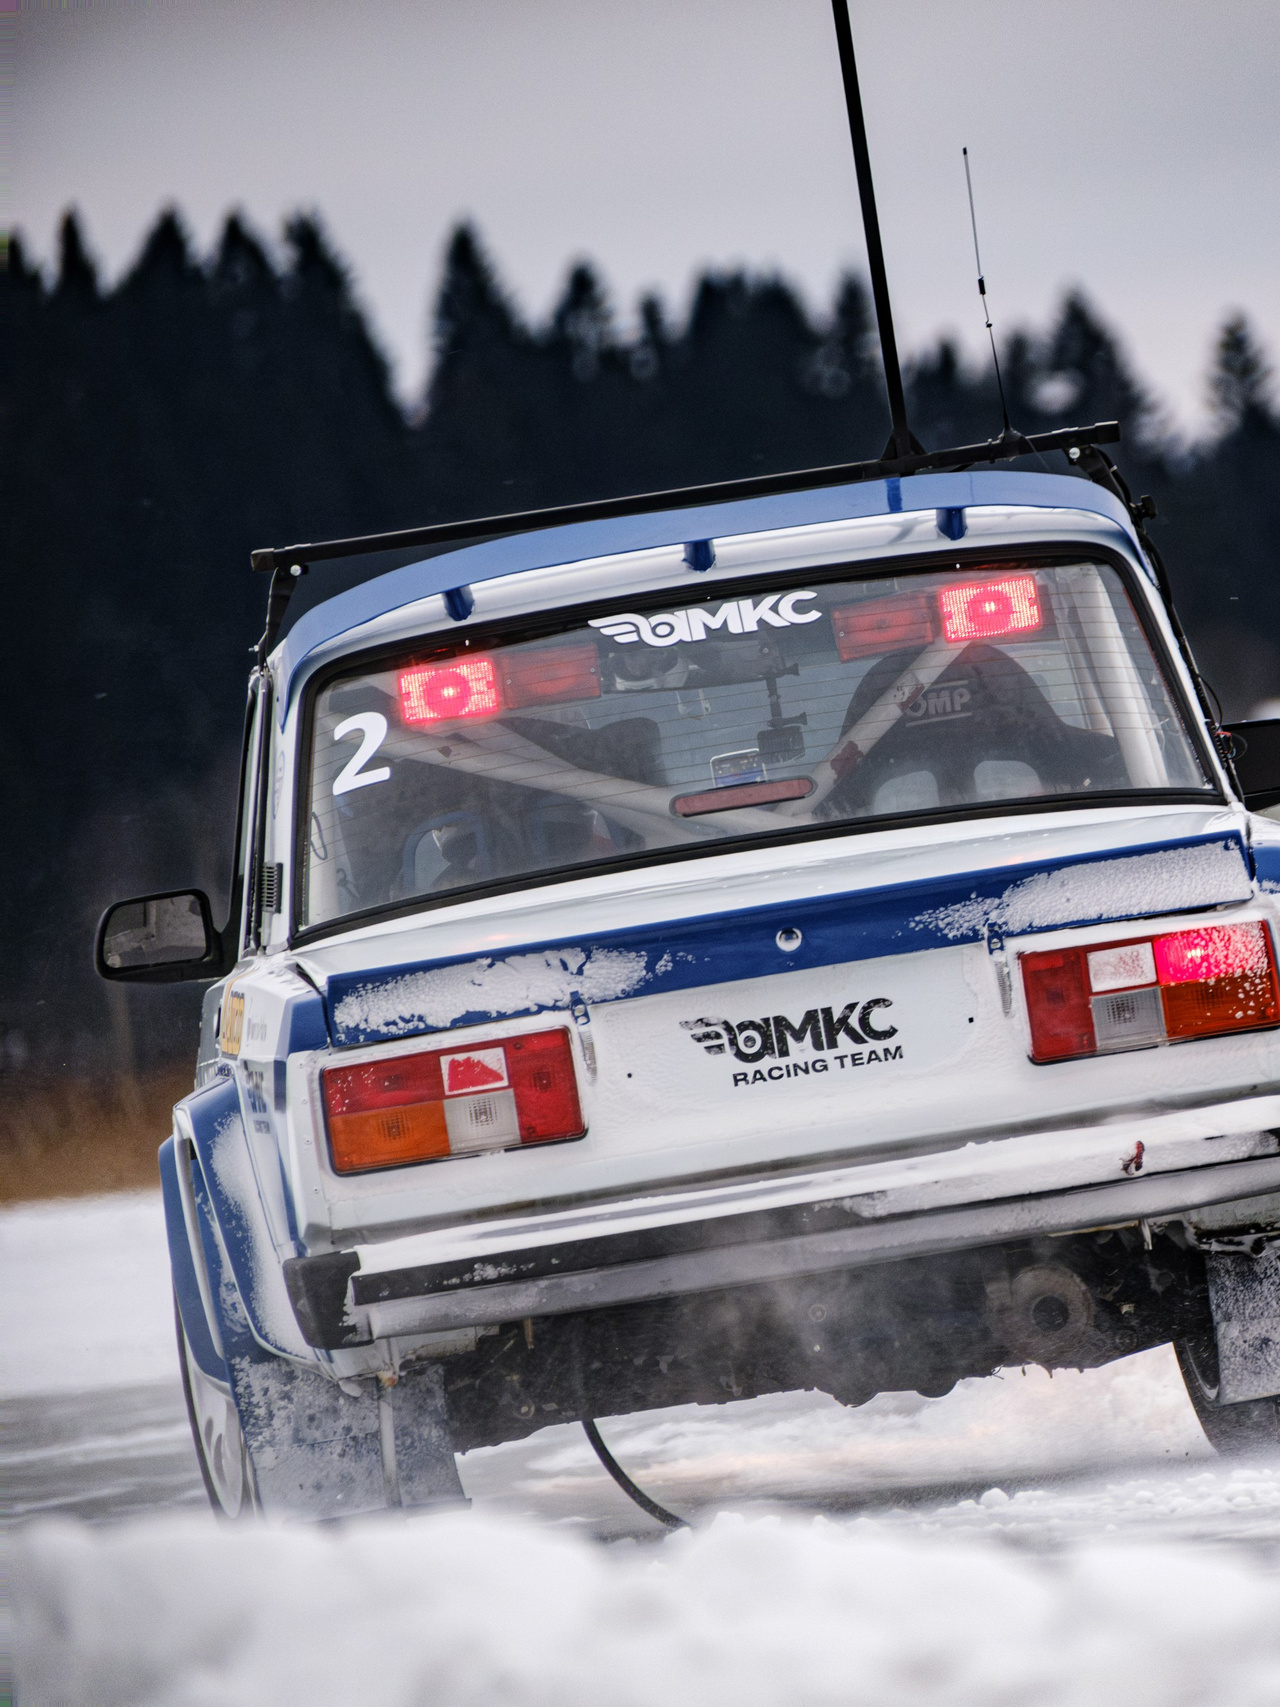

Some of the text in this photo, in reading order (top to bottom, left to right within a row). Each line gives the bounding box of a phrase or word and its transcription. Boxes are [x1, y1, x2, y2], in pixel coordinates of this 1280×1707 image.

[332, 711, 391, 796] 2
[732, 1045, 904, 1087] RACING TEAM
